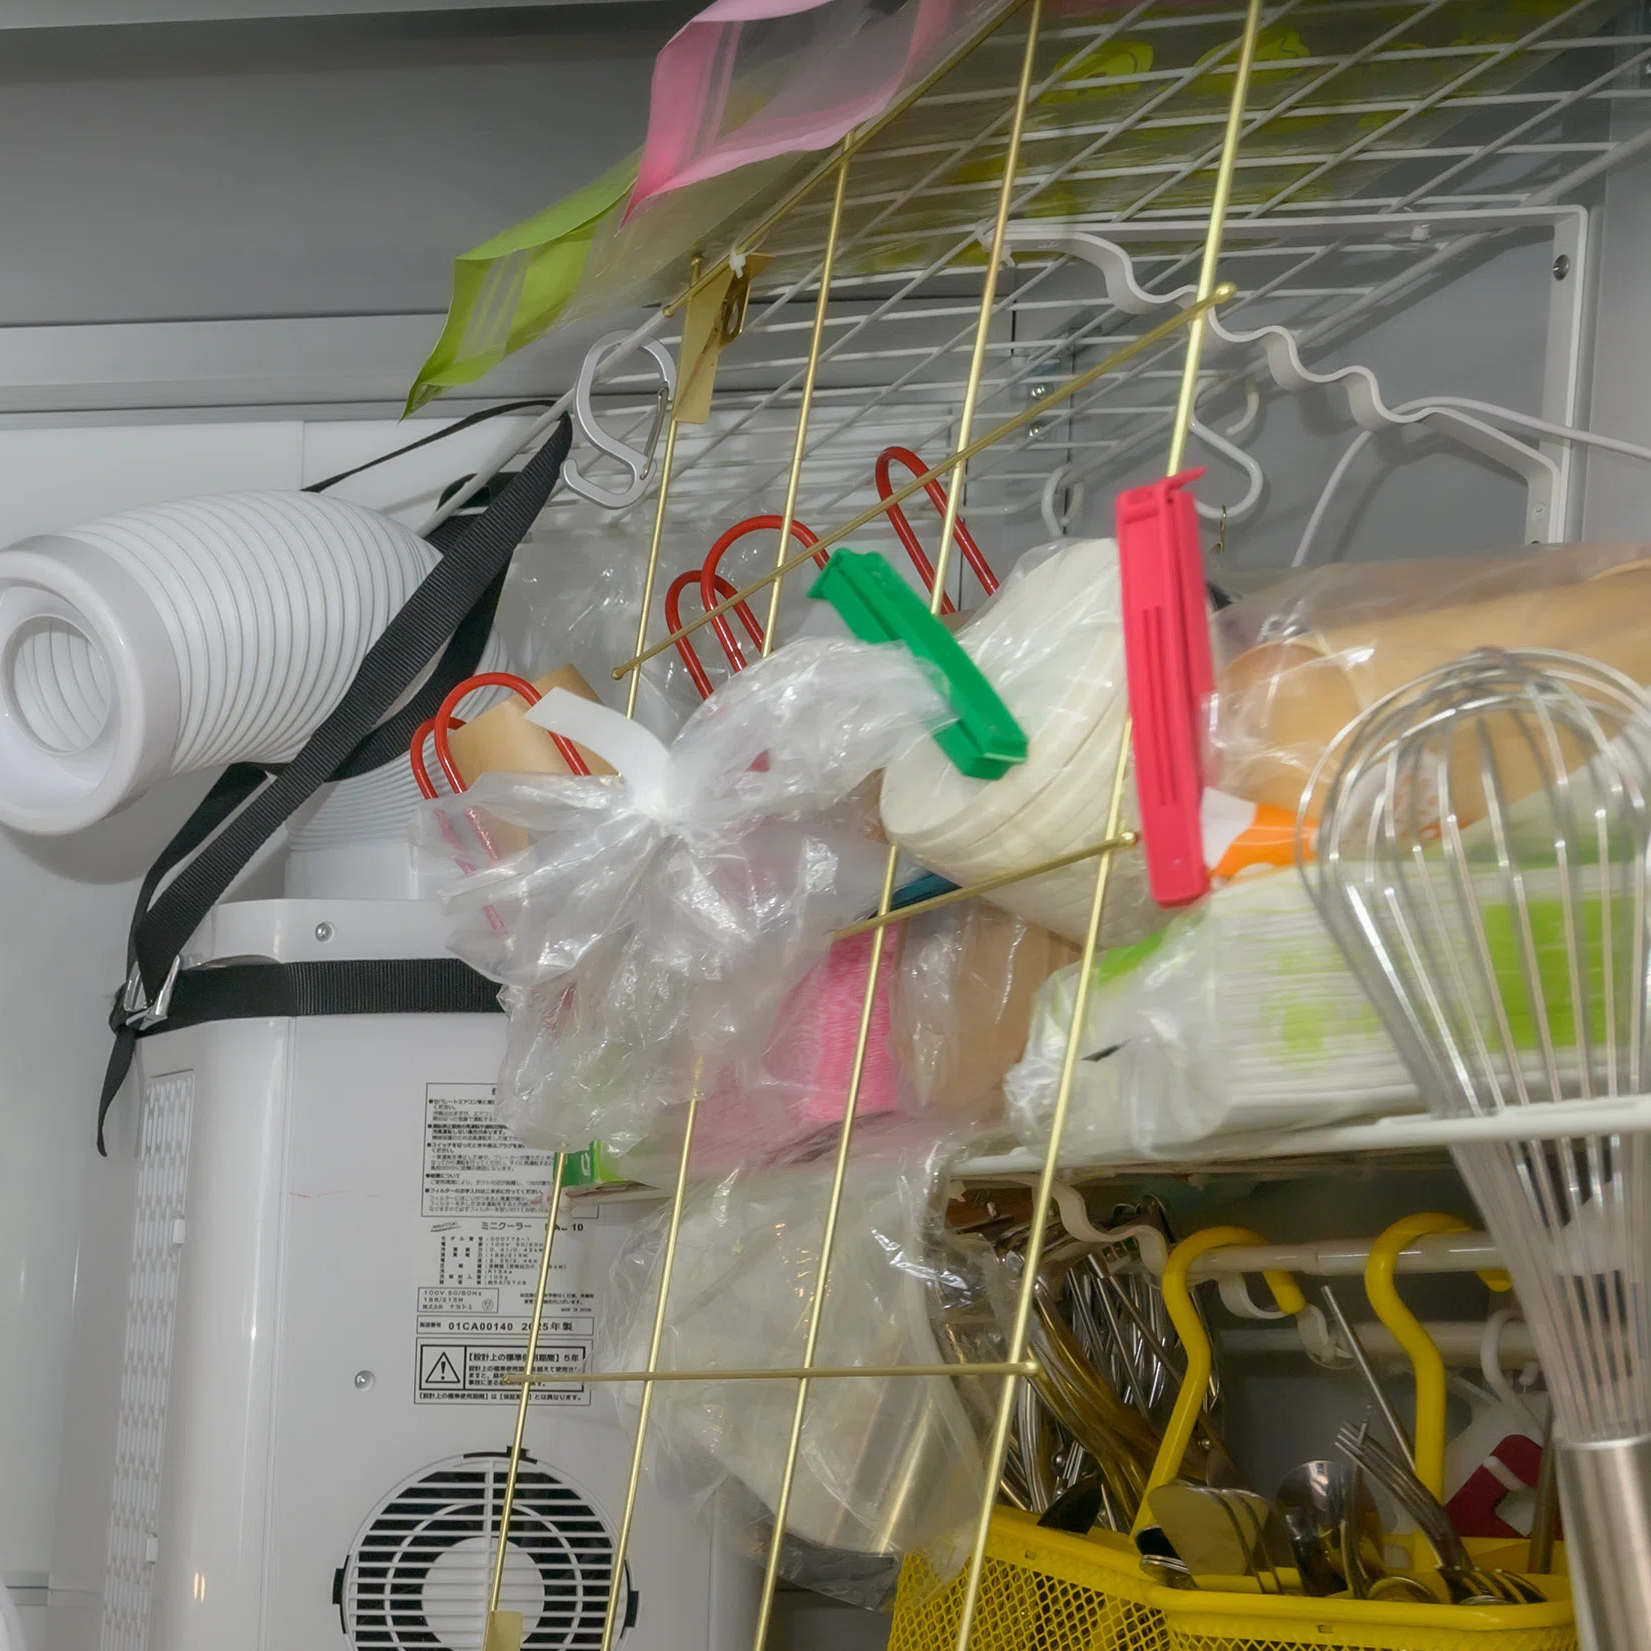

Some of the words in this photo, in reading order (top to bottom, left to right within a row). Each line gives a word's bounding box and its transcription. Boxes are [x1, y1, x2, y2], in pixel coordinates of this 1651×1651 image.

[481, 1221, 532, 1231] ミニクーラー
[448, 1322, 513, 1331] 01CA00140
[521, 1322, 573, 1331] 25年製
